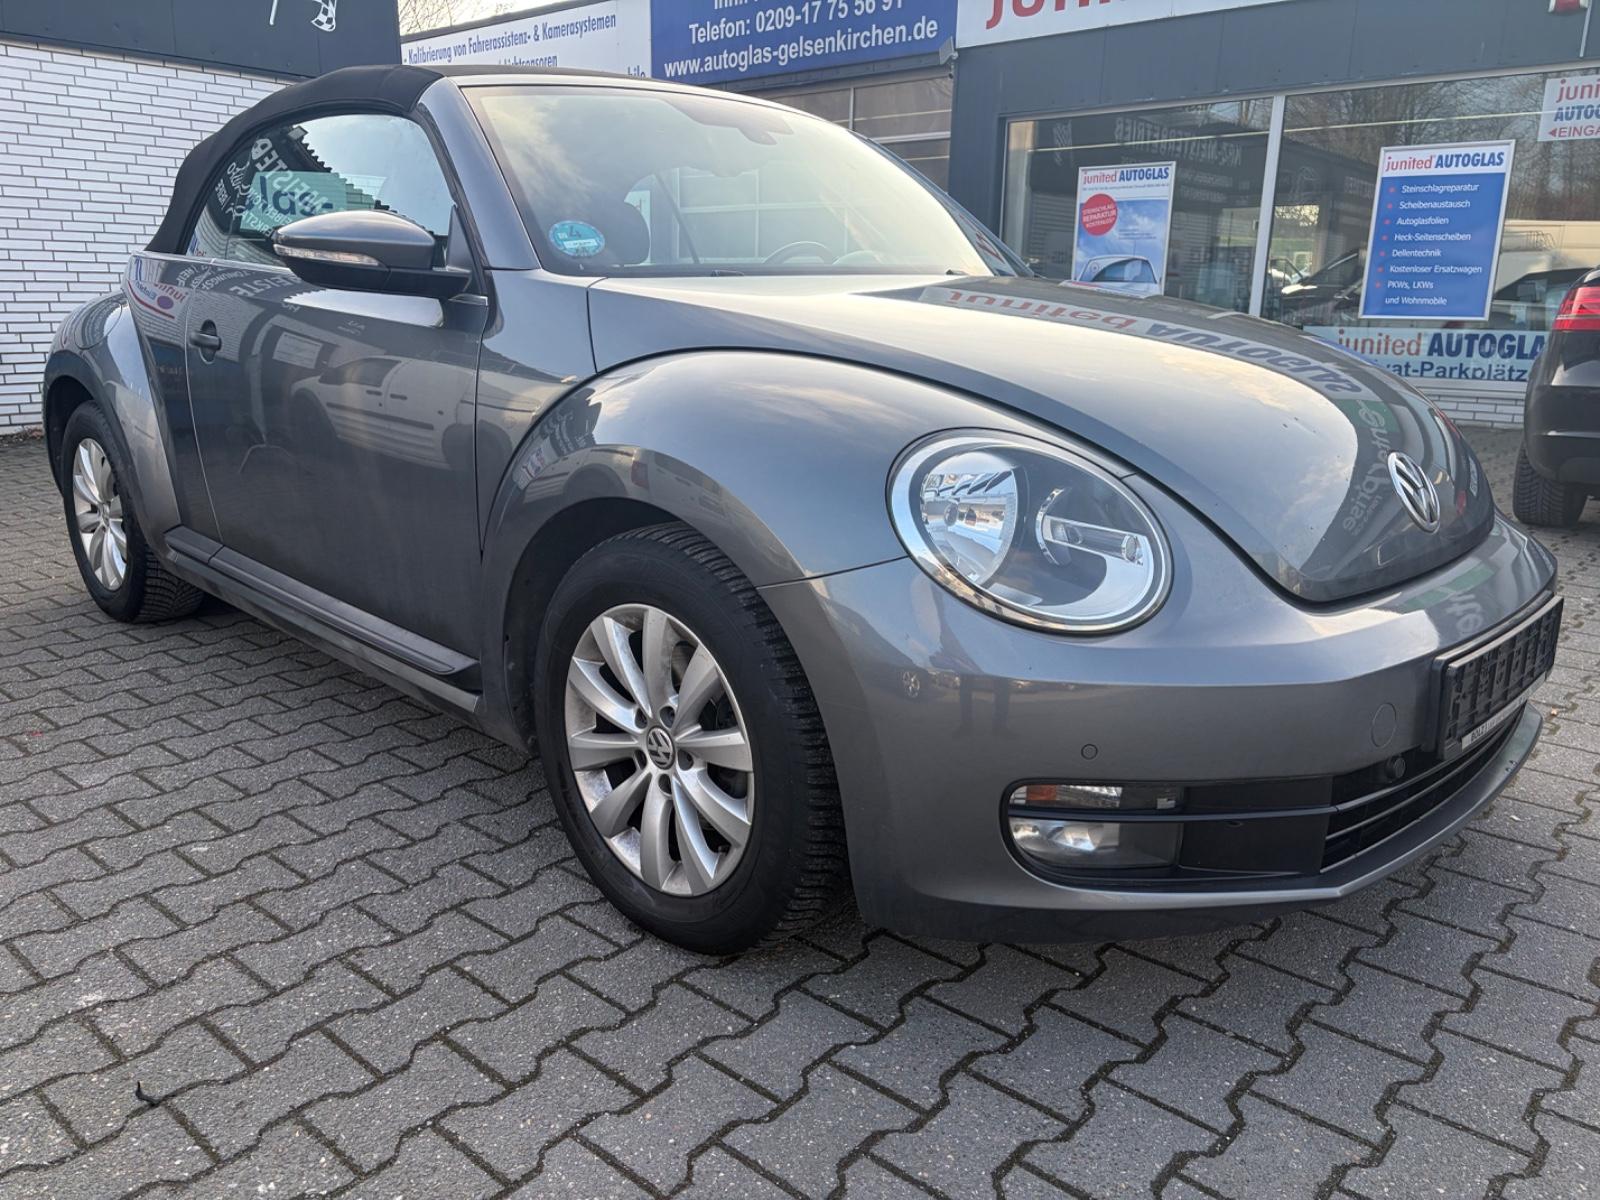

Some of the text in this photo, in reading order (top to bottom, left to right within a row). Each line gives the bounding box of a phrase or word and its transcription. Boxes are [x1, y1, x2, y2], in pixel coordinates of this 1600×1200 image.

[689, 18, 751, 44] Telefon:
[755, 1, 821, 33] 0209-17
[827, 0, 848, 20] 75
[408, 14, 616, 64] Kalibrierung von Fahrerassistenz- & Kamerasystemen
[664, 16, 938, 78] www.autoglas-gelsenkirchen.de
[1385, 151, 1504, 172] junited AUTOGLAS
[1083, 167, 1170, 185] junited AUTOGLAS
[1401, 183, 1479, 194] Steinschlagreparatur
[1399, 200, 1470, 210] Scheibenaustausch
[1396, 216, 1449, 226] Autoglasfolien
[1394, 232, 1472, 242] Heck-Seitenscheiben
[1392, 249, 1441, 258] Dellentechnik
[1389, 264, 1482, 275] Kostenloser Ersatzwagen
[1387, 280, 1434, 290] PKWs, LKWs
[1385, 296, 1447, 306] und Wohnmobile
